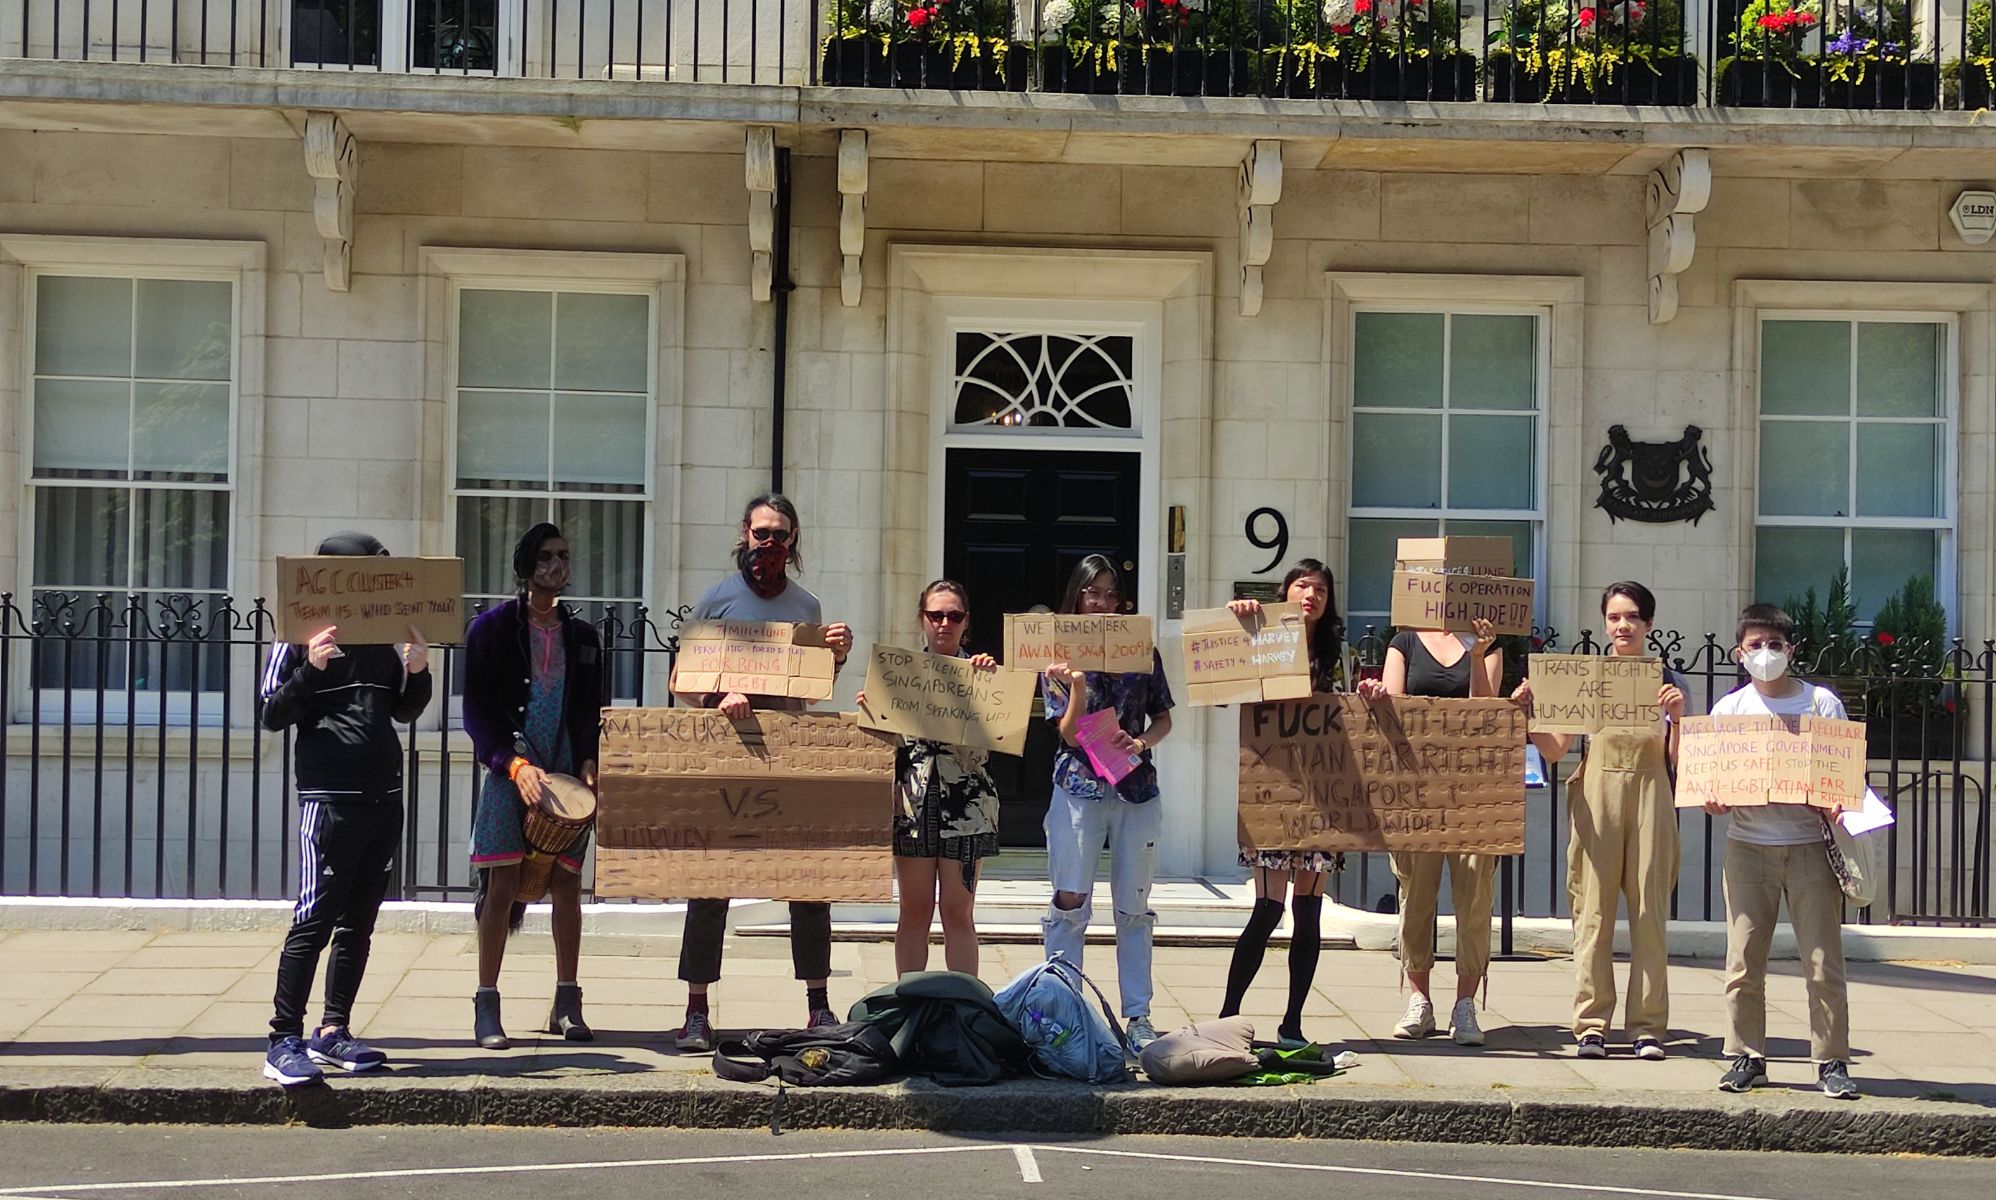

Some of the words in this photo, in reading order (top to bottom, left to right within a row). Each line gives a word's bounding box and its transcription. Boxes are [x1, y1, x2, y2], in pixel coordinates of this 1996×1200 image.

[1245, 507, 1289, 574] 9
[1408, 578, 1454, 594] FUCK
[1460, 581, 1531, 597] OPERATION
[288, 601, 331, 620] TEAM
[361, 603, 392, 619] WHO
[394, 602, 423, 616] SENT
[1425, 600, 1467, 620] HIGH
[761, 627, 787, 637] LUNE
[1024, 621, 1046, 635] WE
[1053, 620, 1130, 635] REMEMBER
[1251, 630, 1300, 647] HARVEY
[1019, 642, 1072, 660] AWARE
[1079, 644, 1106, 659] SAGA
[1251, 650, 1297, 667] HARVEY
[701, 658, 734, 672] FOR
[738, 658, 780, 673] BEING
[878, 651, 913, 666] STOP
[922, 658, 993, 683] SILENCING
[1535, 659, 1590, 677] TRANS
[1601, 660, 1662, 678] RIGHTS
[728, 676, 768, 690] LGBT
[882, 670, 1004, 706] SINGAPOREANS
[1577, 680, 1613, 698] ARE
[891, 697, 919, 712] FROM
[926, 703, 980, 723] SPEAKING
[1532, 702, 1595, 719] HUMAN
[1601, 703, 1660, 722] RIGHTS
[1253, 703, 1345, 738] FUCK
[1682, 721, 1747, 738] MESSAGE
[1753, 721, 1769, 735] TO
[1812, 721, 1862, 739] SECULAR
[1362, 742, 1418, 775] FAR
[1685, 741, 1758, 759] SINGAPORE
[1685, 759, 1718, 776] KEEP
[1720, 759, 1738, 772] US
[1785, 759, 1812, 770] STOP
[1816, 759, 1841, 773] THE
[1288, 778, 1428, 808] SINGAPORE
[1686, 778, 1767, 795] ANTI-LGBT
[1774, 778, 1815, 796] XTIAN
[1820, 776, 1846, 793] FAR
[719, 786, 783, 819] V.S.
